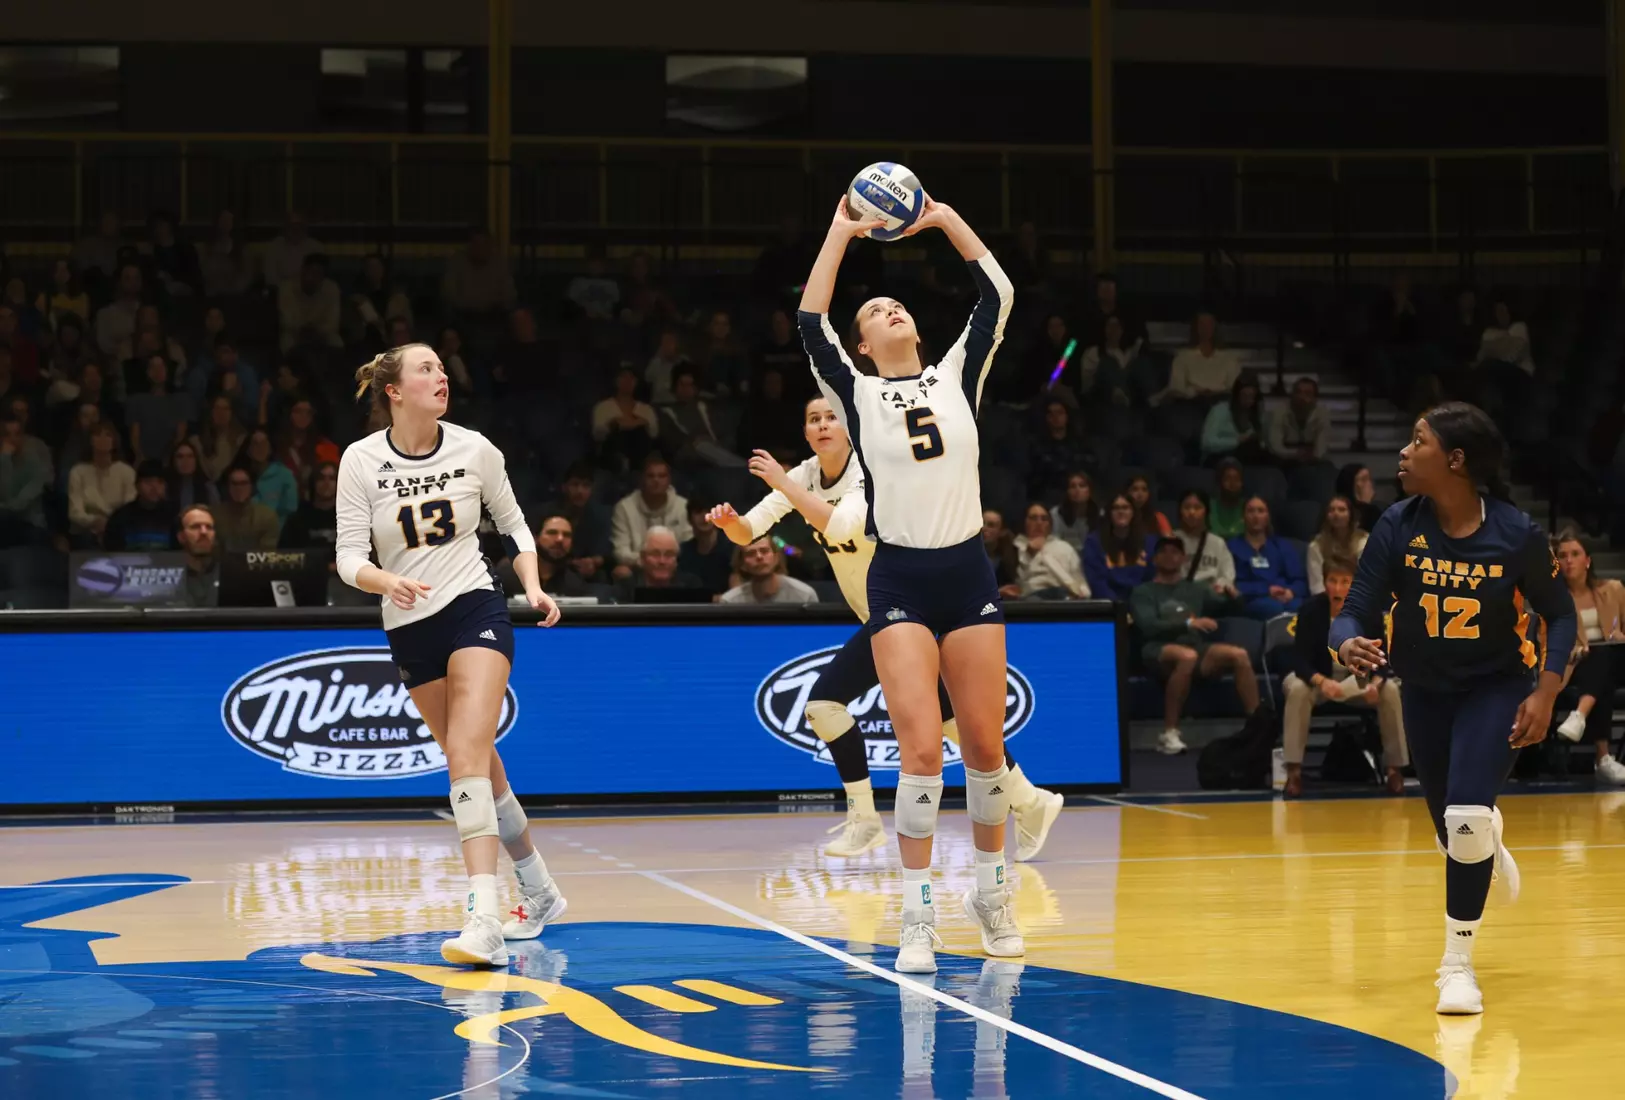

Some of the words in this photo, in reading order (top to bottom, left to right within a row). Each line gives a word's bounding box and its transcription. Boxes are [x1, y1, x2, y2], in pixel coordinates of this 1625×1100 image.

[868, 172, 908, 202] molten
[904, 406, 945, 463] 5
[377, 468, 466, 489] KANSAS
[397, 481, 447, 498] CITY
[396, 498, 456, 550] 13
[126, 565, 185, 578] INSTANT
[1404, 553, 1504, 578] KANSAS
[129, 575, 181, 587] REPLAY
[1421, 570, 1484, 591] CITY
[1418, 592, 1482, 640] 12
[328, 727, 365, 742] CAFE
[380, 727, 410, 742] BAR
[858, 719, 893, 734] CAFE
[310, 749, 432, 771] PIZZA
[778, 793, 835, 802] DAKTRONICS
